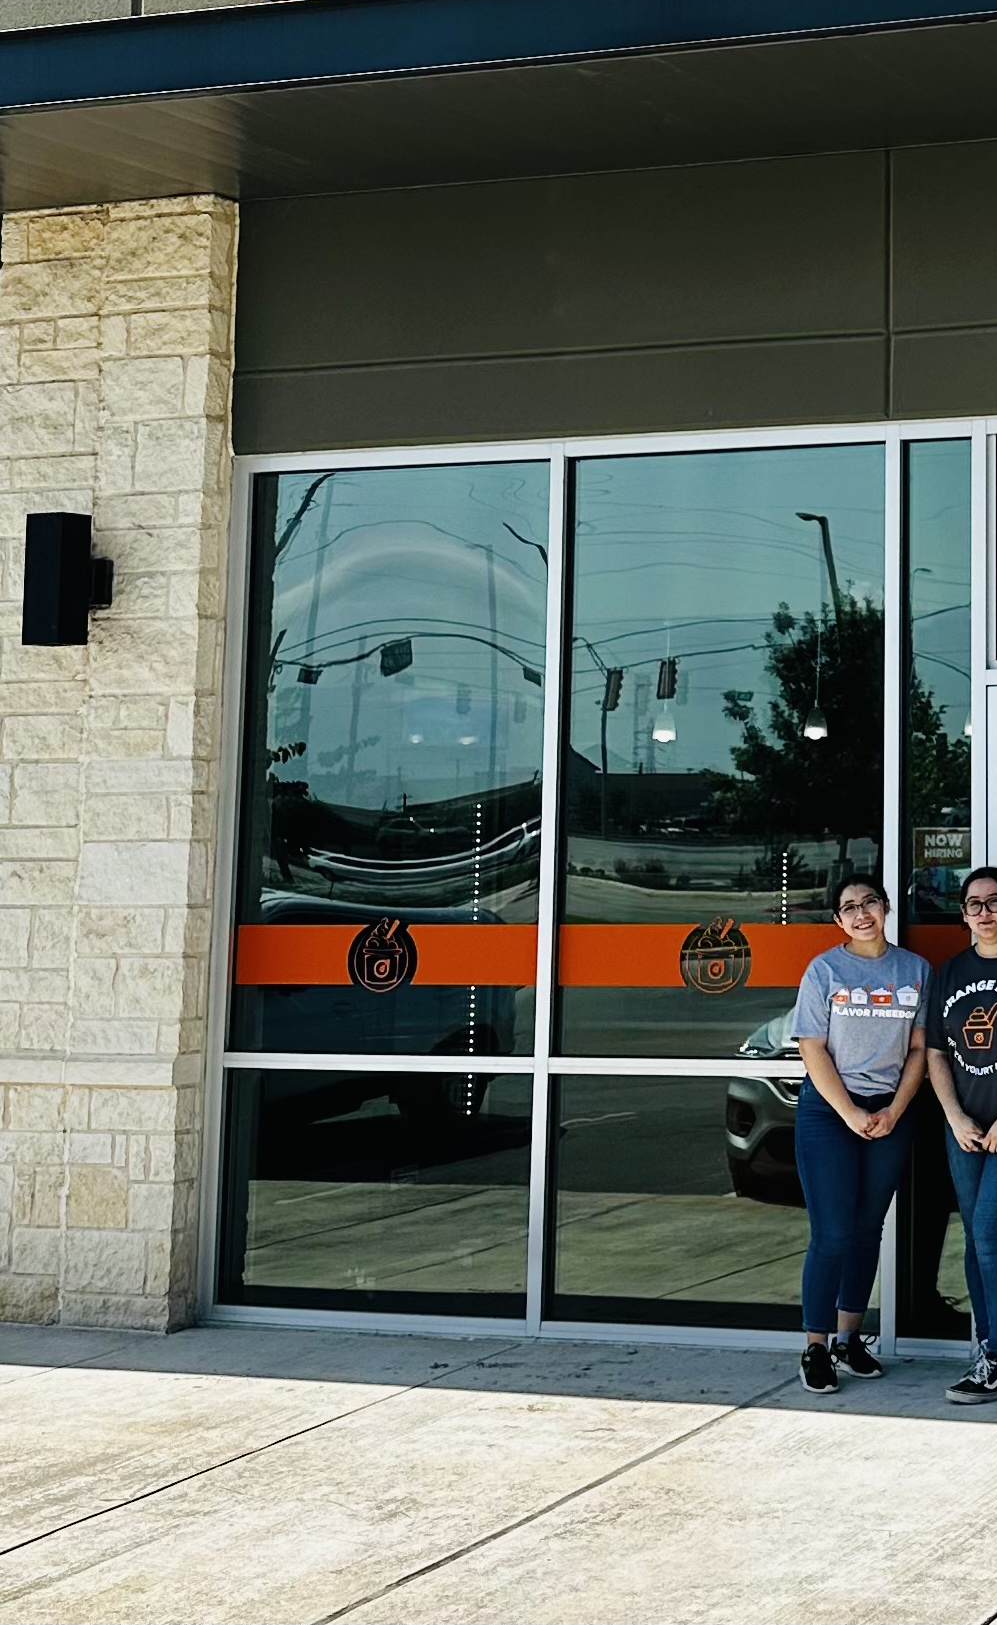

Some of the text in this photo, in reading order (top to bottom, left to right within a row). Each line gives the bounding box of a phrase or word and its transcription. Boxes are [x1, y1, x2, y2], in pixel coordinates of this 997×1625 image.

[924, 833, 964, 847] NOW
[924, 848, 964, 858] HIRING
[832, 1005, 871, 1017] FLAVOR
